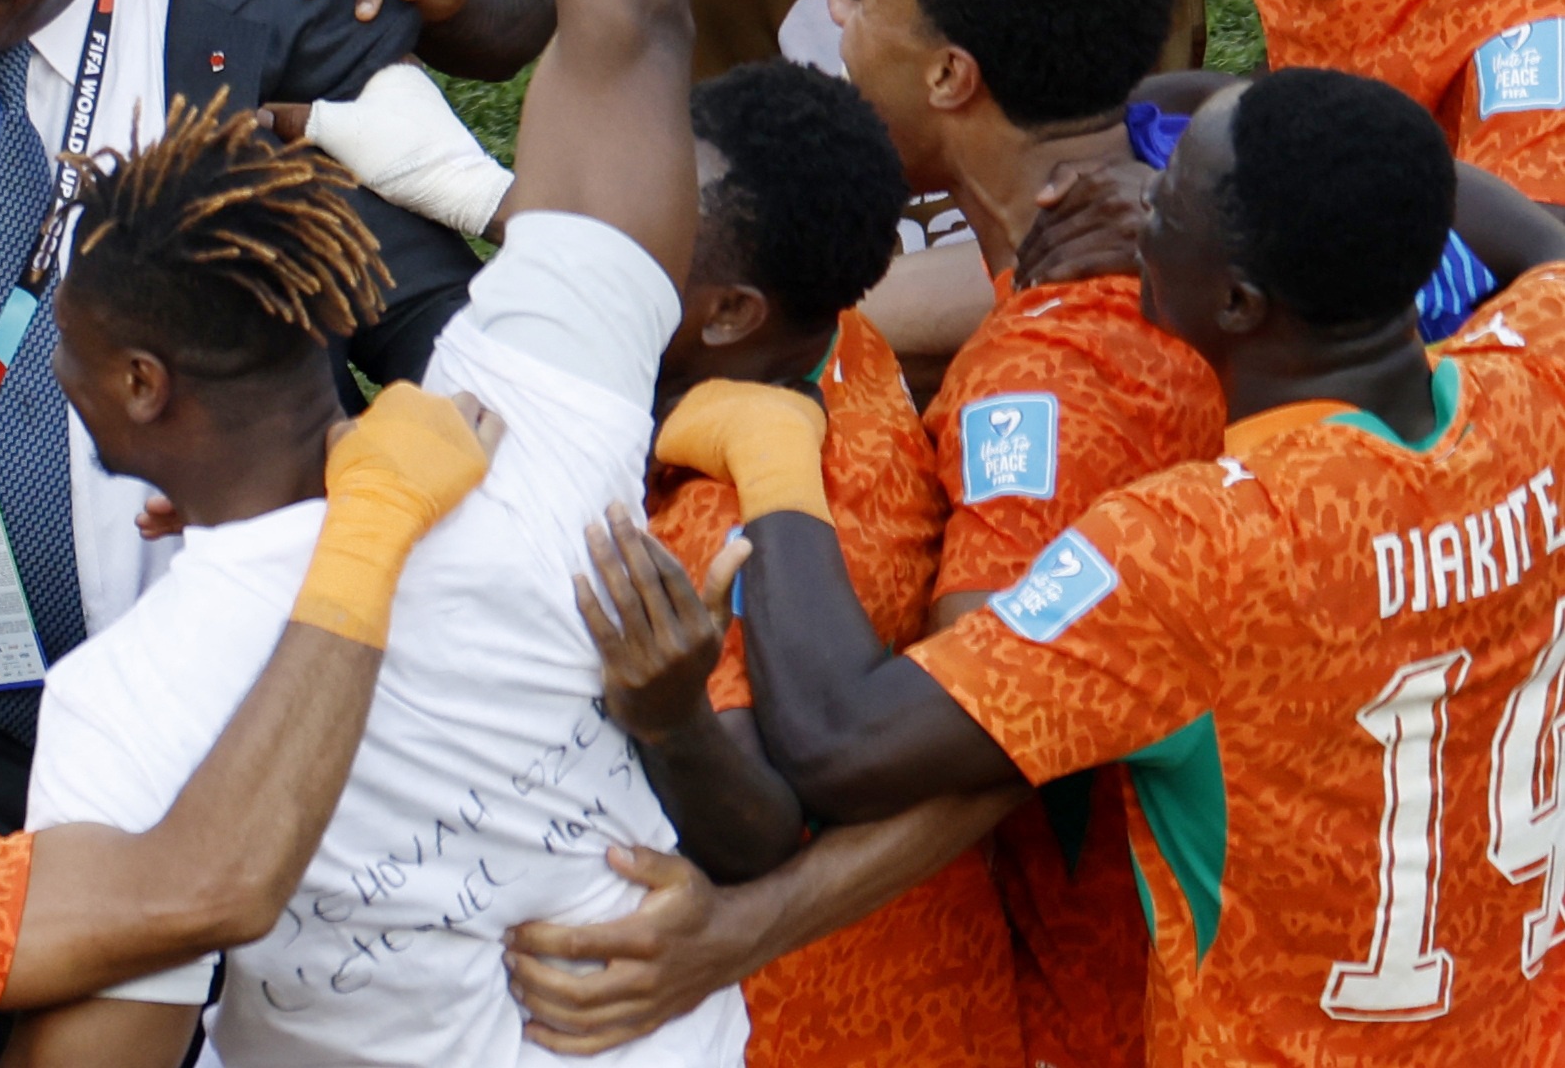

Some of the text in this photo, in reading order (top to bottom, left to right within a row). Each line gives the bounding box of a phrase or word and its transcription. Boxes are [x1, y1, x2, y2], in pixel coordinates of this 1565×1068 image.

[1495, 67, 1539, 90] PEACE
[1502, 88, 1529, 100] FIFA
[60, 30, 107, 199] FIFA WORLD UP
[985, 453, 1028, 479] PEACE
[1372, 465, 1565, 620] DIAKITE
